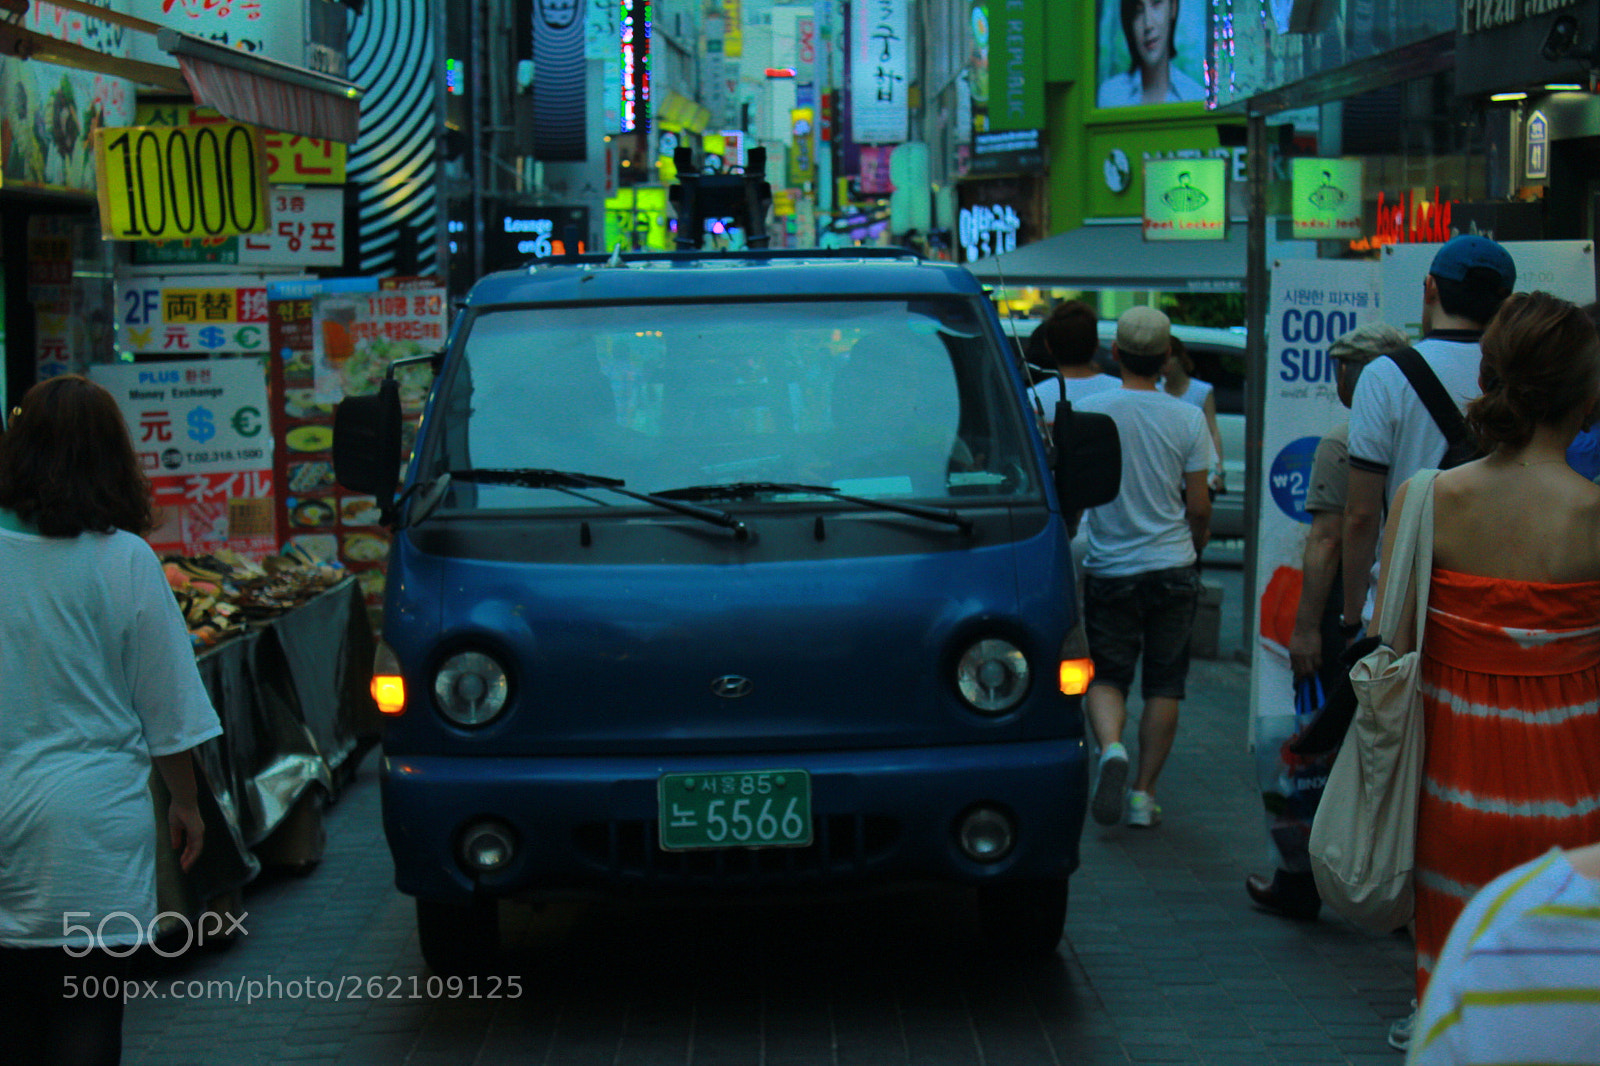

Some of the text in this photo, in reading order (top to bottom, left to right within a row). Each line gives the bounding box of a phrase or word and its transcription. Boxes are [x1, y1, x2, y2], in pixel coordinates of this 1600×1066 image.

[108, 126, 257, 237] 10000
[124, 289, 159, 324] 2F
[1284, 287, 1324, 306] 시원한
[1328, 289, 1369, 307] 피자몰
[163, 327, 189, 349] 元
[138, 371, 180, 383] PLUS
[129, 387, 223, 402] Money Exchange
[140, 405, 263, 444] 元 $ €
[740, 775, 773, 795] 85
[670, 797, 803, 842] 노 5566
